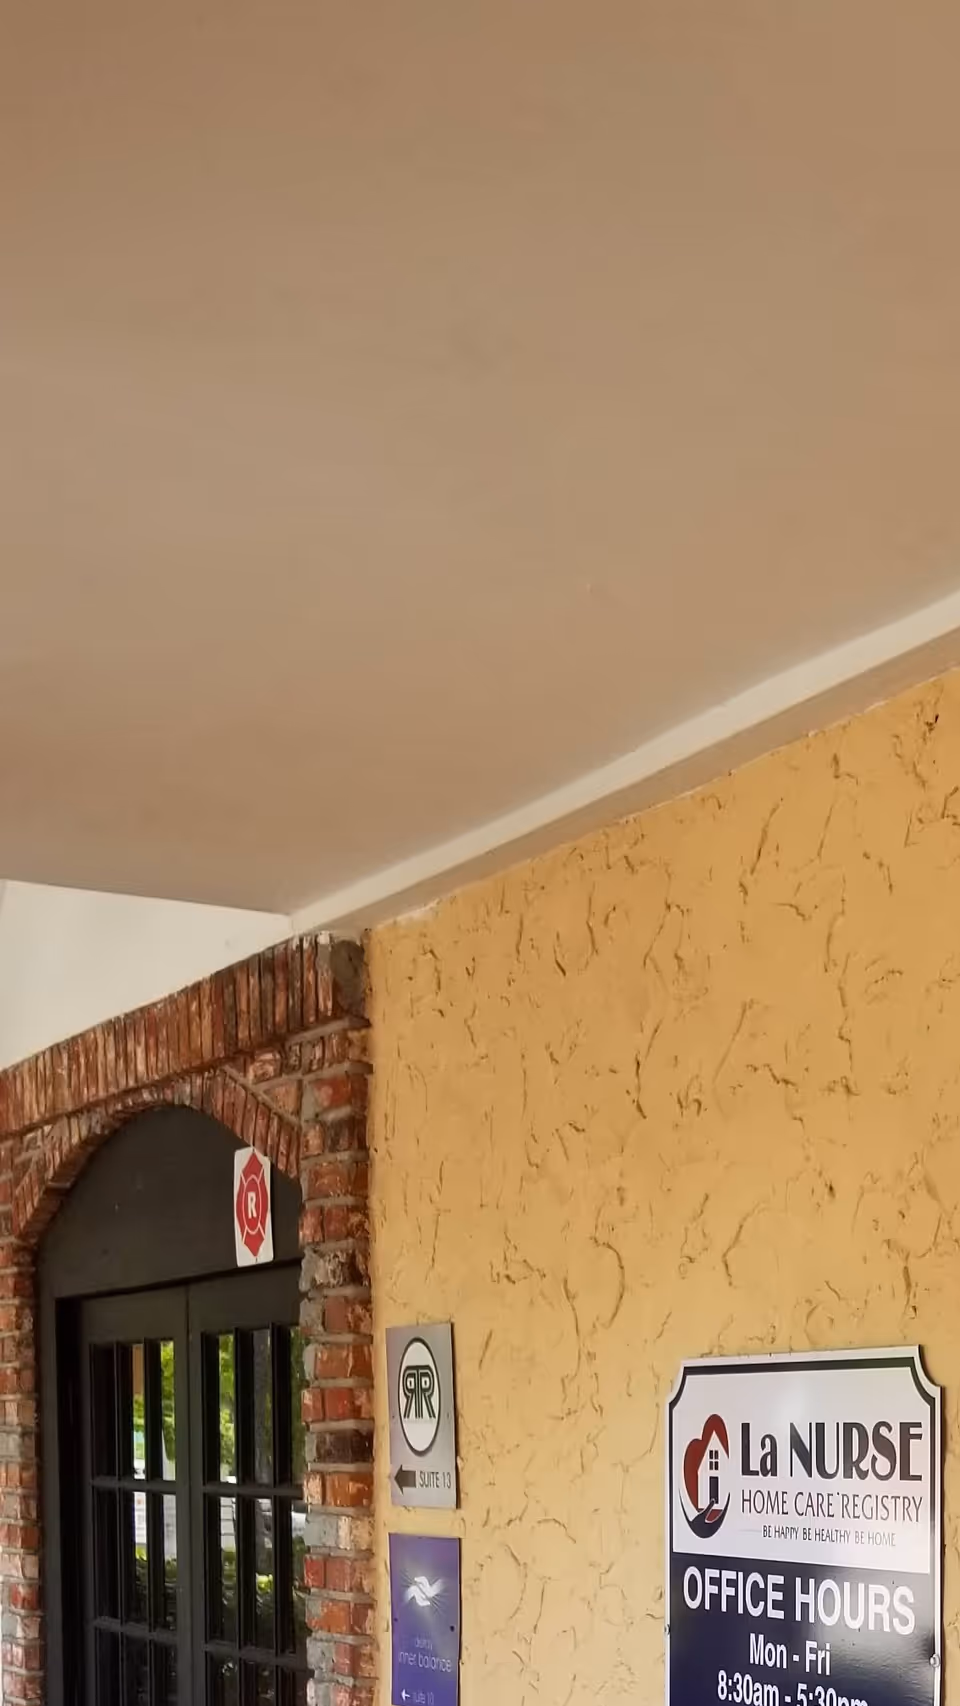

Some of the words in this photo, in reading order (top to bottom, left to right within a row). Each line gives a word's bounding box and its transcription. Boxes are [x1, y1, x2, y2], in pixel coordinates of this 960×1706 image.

[248, 1191, 257, 1219] R
[740, 1421, 778, 1478] La
[789, 1420, 923, 1482] NURSE
[419, 1470, 440, 1489] SUITE
[741, 1489, 789, 1516] HOME
[794, 1491, 835, 1518] CARE
[841, 1493, 923, 1523] REGISTRY
[762, 1525, 772, 1538] BE
[774, 1525, 799, 1540] HAPPY
[802, 1527, 812, 1541] BE
[814, 1528, 851, 1544] HEALTHY
[855, 1530, 865, 1545] BE
[867, 1531, 896, 1547] HOME
[683, 1565, 785, 1620] OFFICE
[794, 1576, 915, 1635] HOURS
[749, 1632, 787, 1669] Mon
[805, 1640, 831, 1676] Fri
